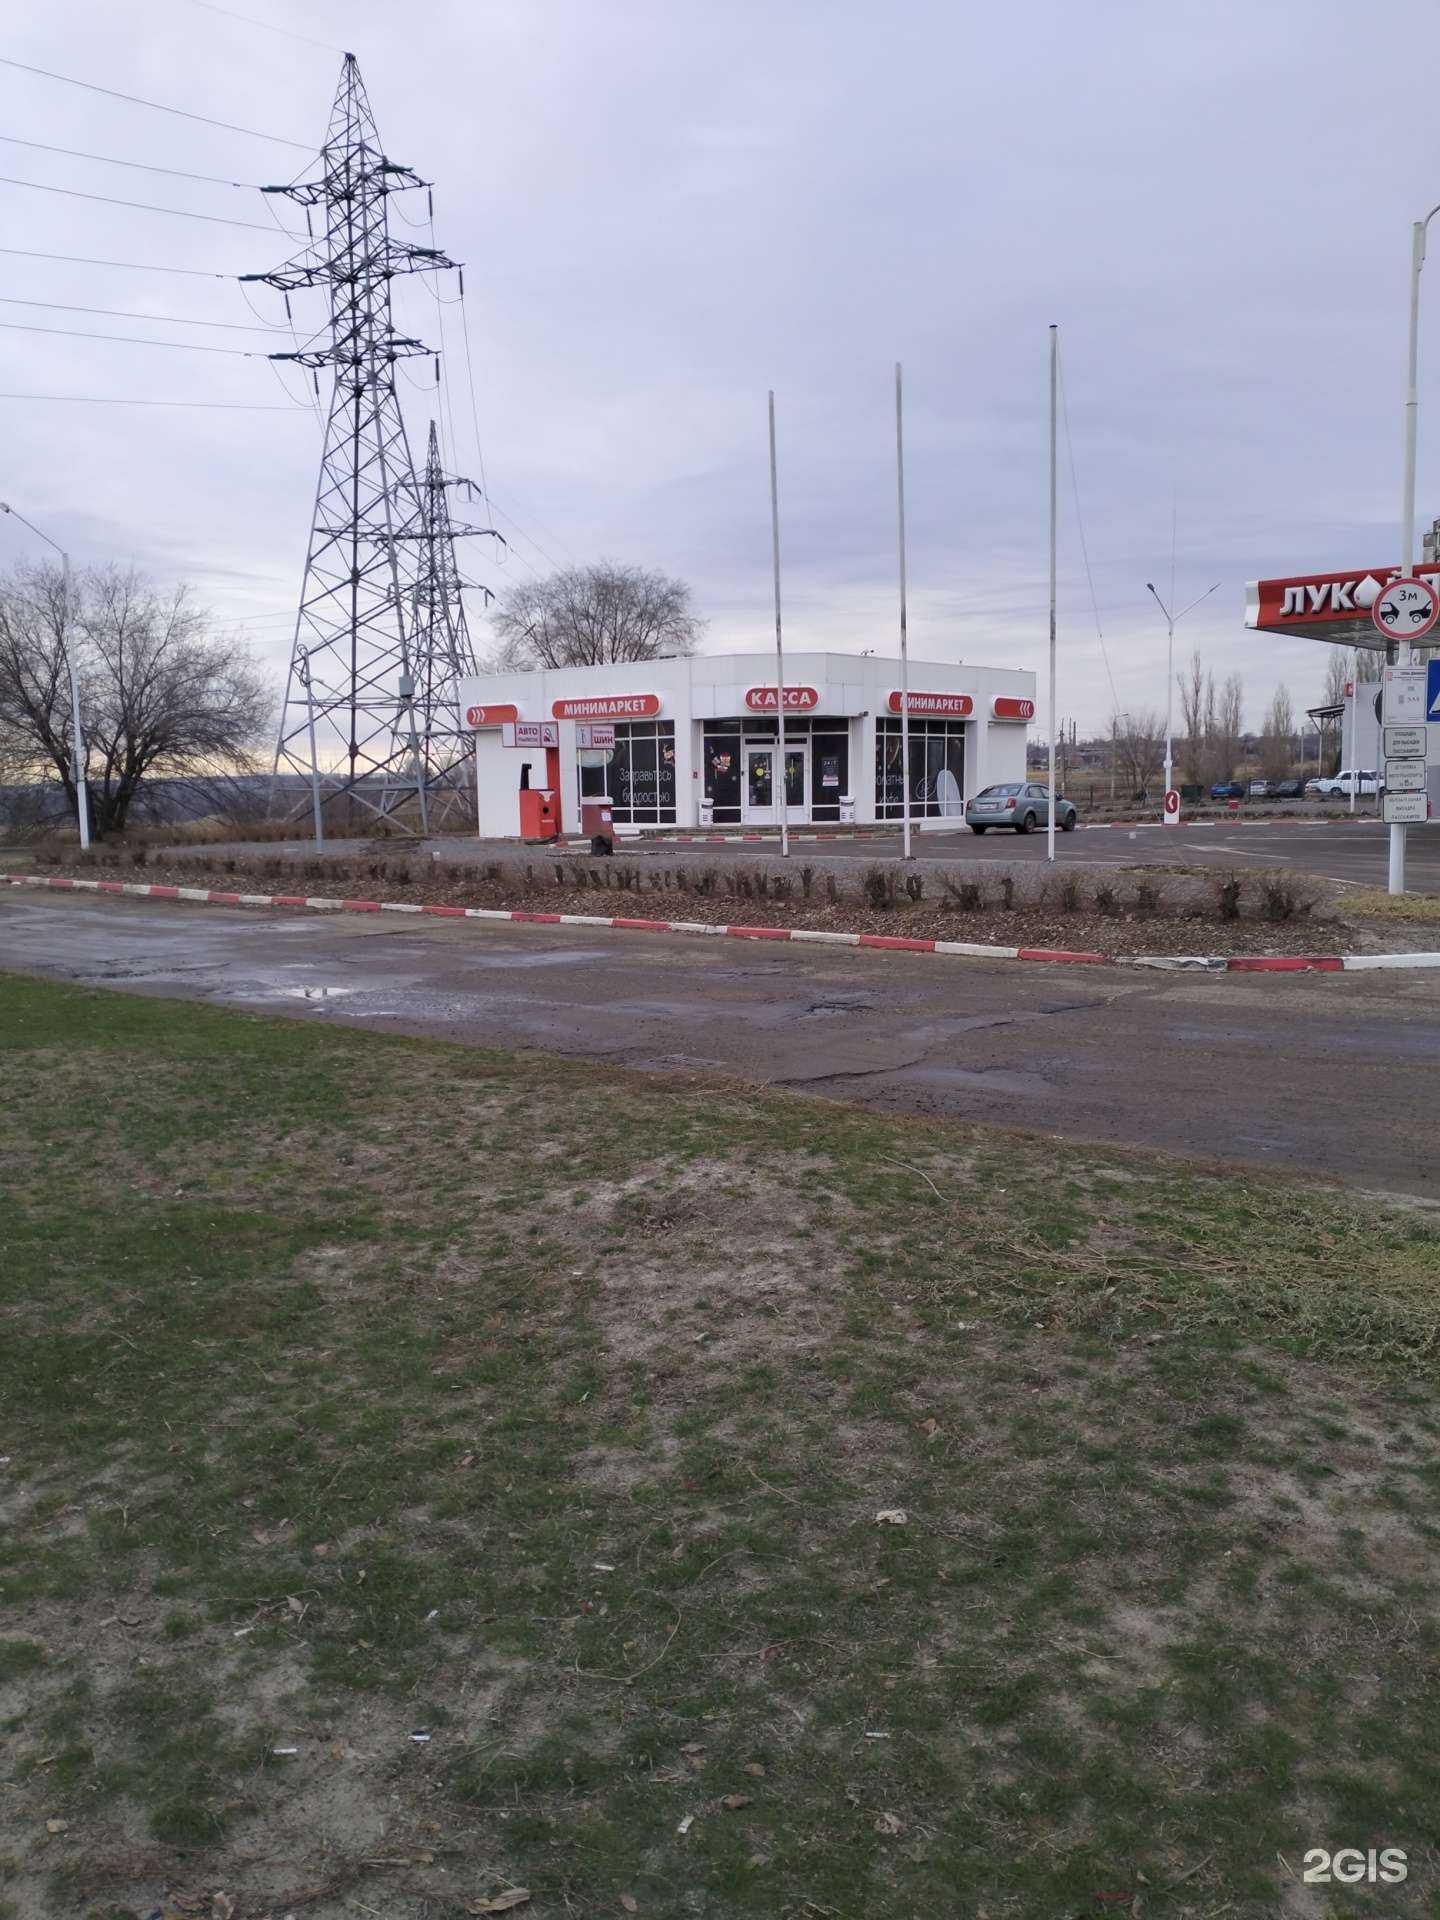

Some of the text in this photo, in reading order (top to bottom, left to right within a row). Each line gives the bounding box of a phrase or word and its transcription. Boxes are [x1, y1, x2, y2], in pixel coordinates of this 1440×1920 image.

[1280, 571, 1439, 616] ЛУКО
[752, 691, 811, 705] КАССА
[564, 699, 646, 715] МИНИМАРКЕТ
[518, 727, 538, 735] АВТО
[594, 736, 613, 744] ШИН
